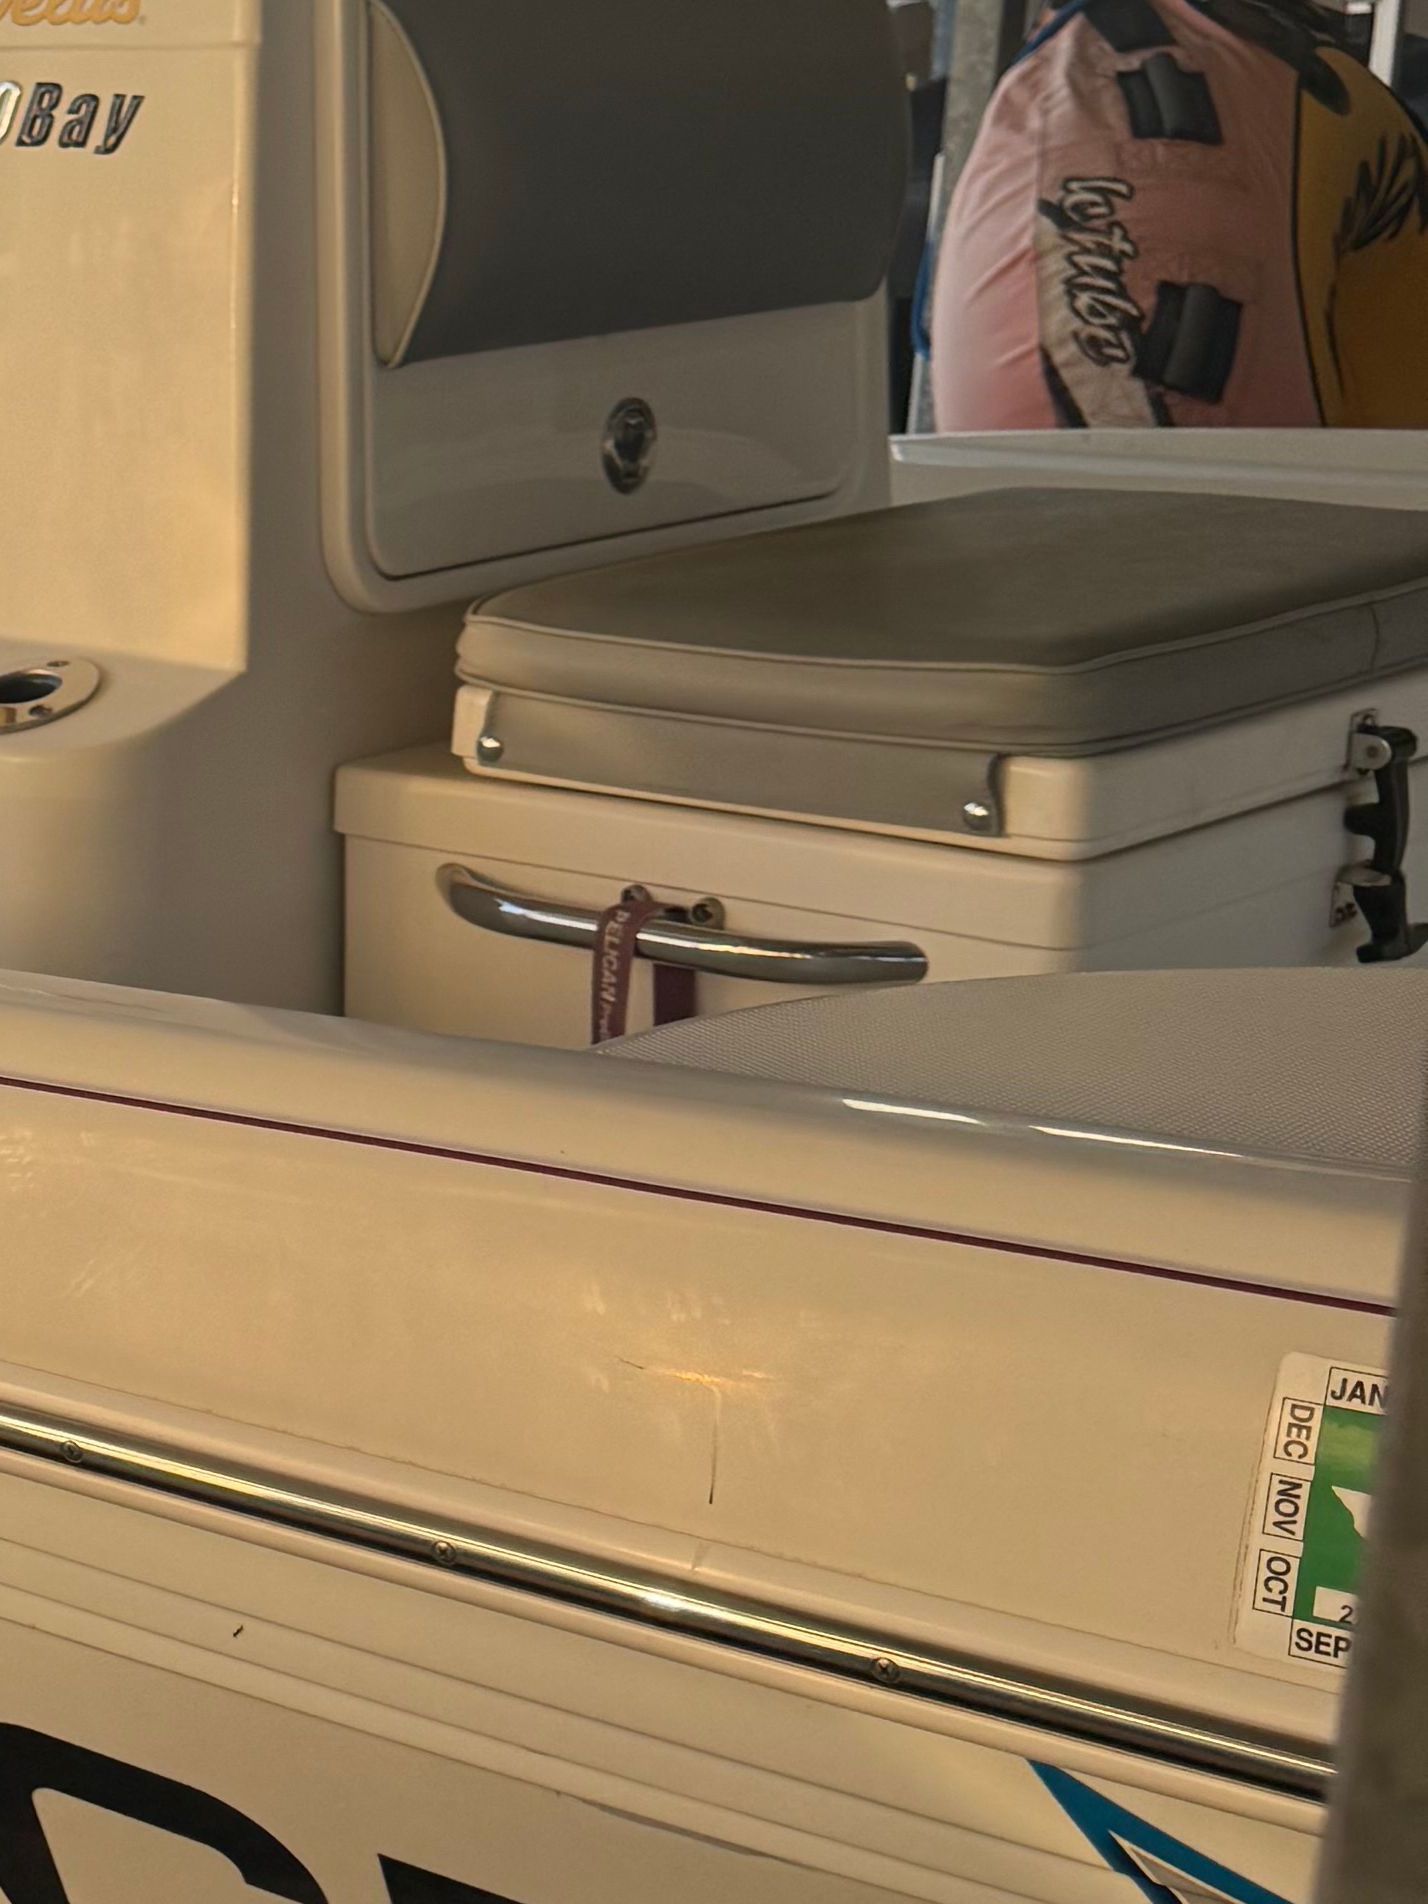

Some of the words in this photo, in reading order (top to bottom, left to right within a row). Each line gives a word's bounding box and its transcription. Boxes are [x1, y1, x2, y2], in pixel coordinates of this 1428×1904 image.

[1282, 1402, 1315, 1460] DEC
[1272, 1478, 1303, 1537] NOV
[1262, 1555, 1292, 1613] OCT
[1294, 1627, 1352, 1659] SEP
